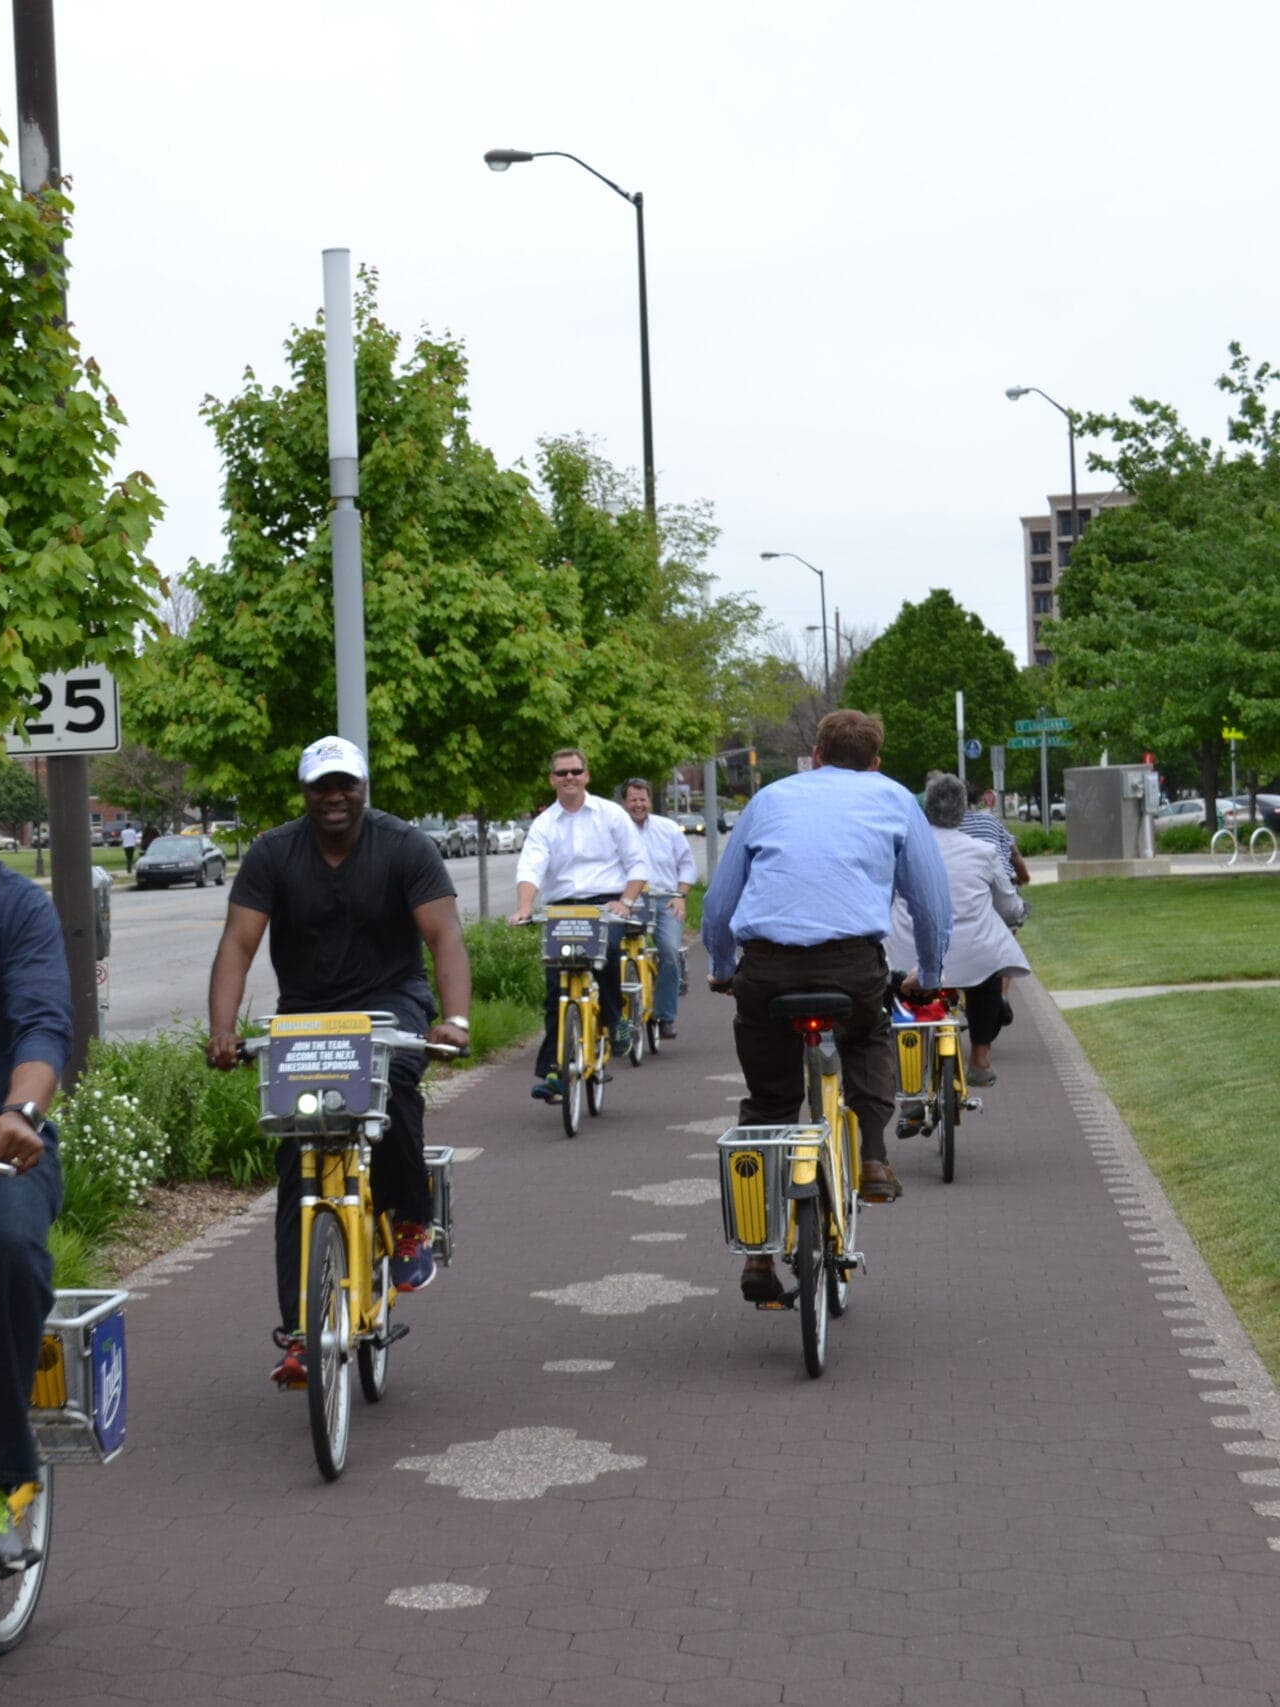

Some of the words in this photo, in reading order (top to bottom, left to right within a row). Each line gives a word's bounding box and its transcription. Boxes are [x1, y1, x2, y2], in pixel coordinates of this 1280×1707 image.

[14, 679, 105, 735] 25
[312, 1040, 326, 1050] THE
[285, 1051, 318, 1062] BECOME
[319, 1051, 334, 1060] THE
[335, 1050, 356, 1060] NEXT
